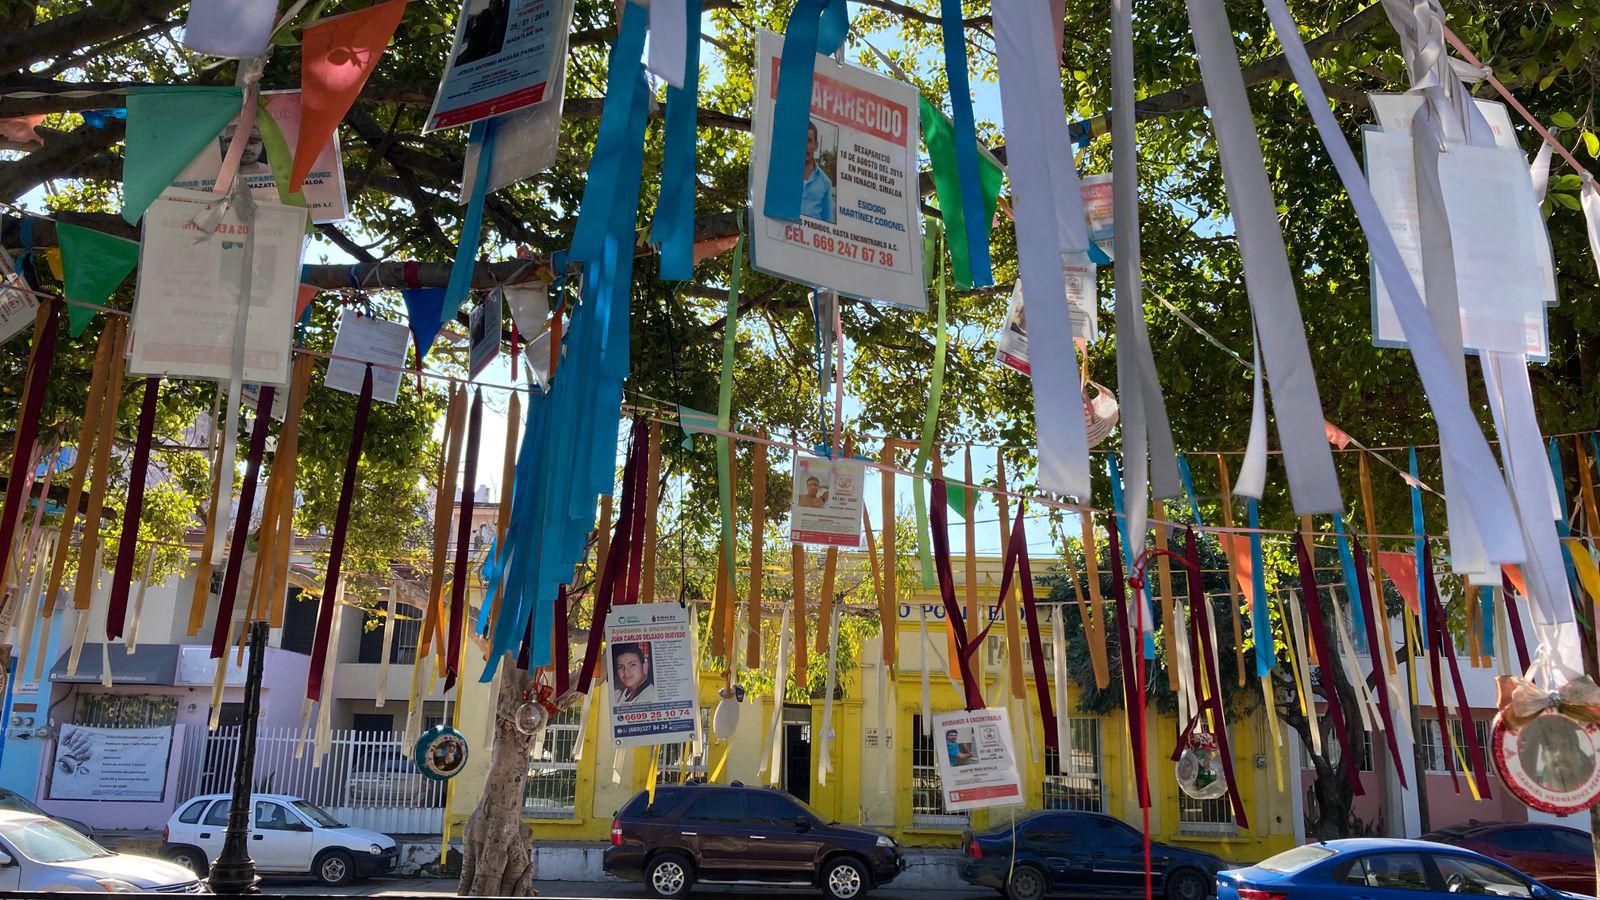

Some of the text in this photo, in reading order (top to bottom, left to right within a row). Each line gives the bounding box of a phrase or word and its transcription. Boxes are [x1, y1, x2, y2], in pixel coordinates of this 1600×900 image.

[848, 152, 857, 162] DE
[859, 156, 878, 170] AGOSTO
[879, 163, 889, 174] DEL
[840, 172, 852, 183] SAN
[879, 184, 903, 198] SINALOA
[848, 164, 895, 186] EN PUEBLO VIEJO
[833, 228, 849, 240] HASTA
[875, 216, 906, 232] CORONEL
[785, 225, 894, 267] CEL. 669 247 67 38
[625, 712, 647, 720] 6699
